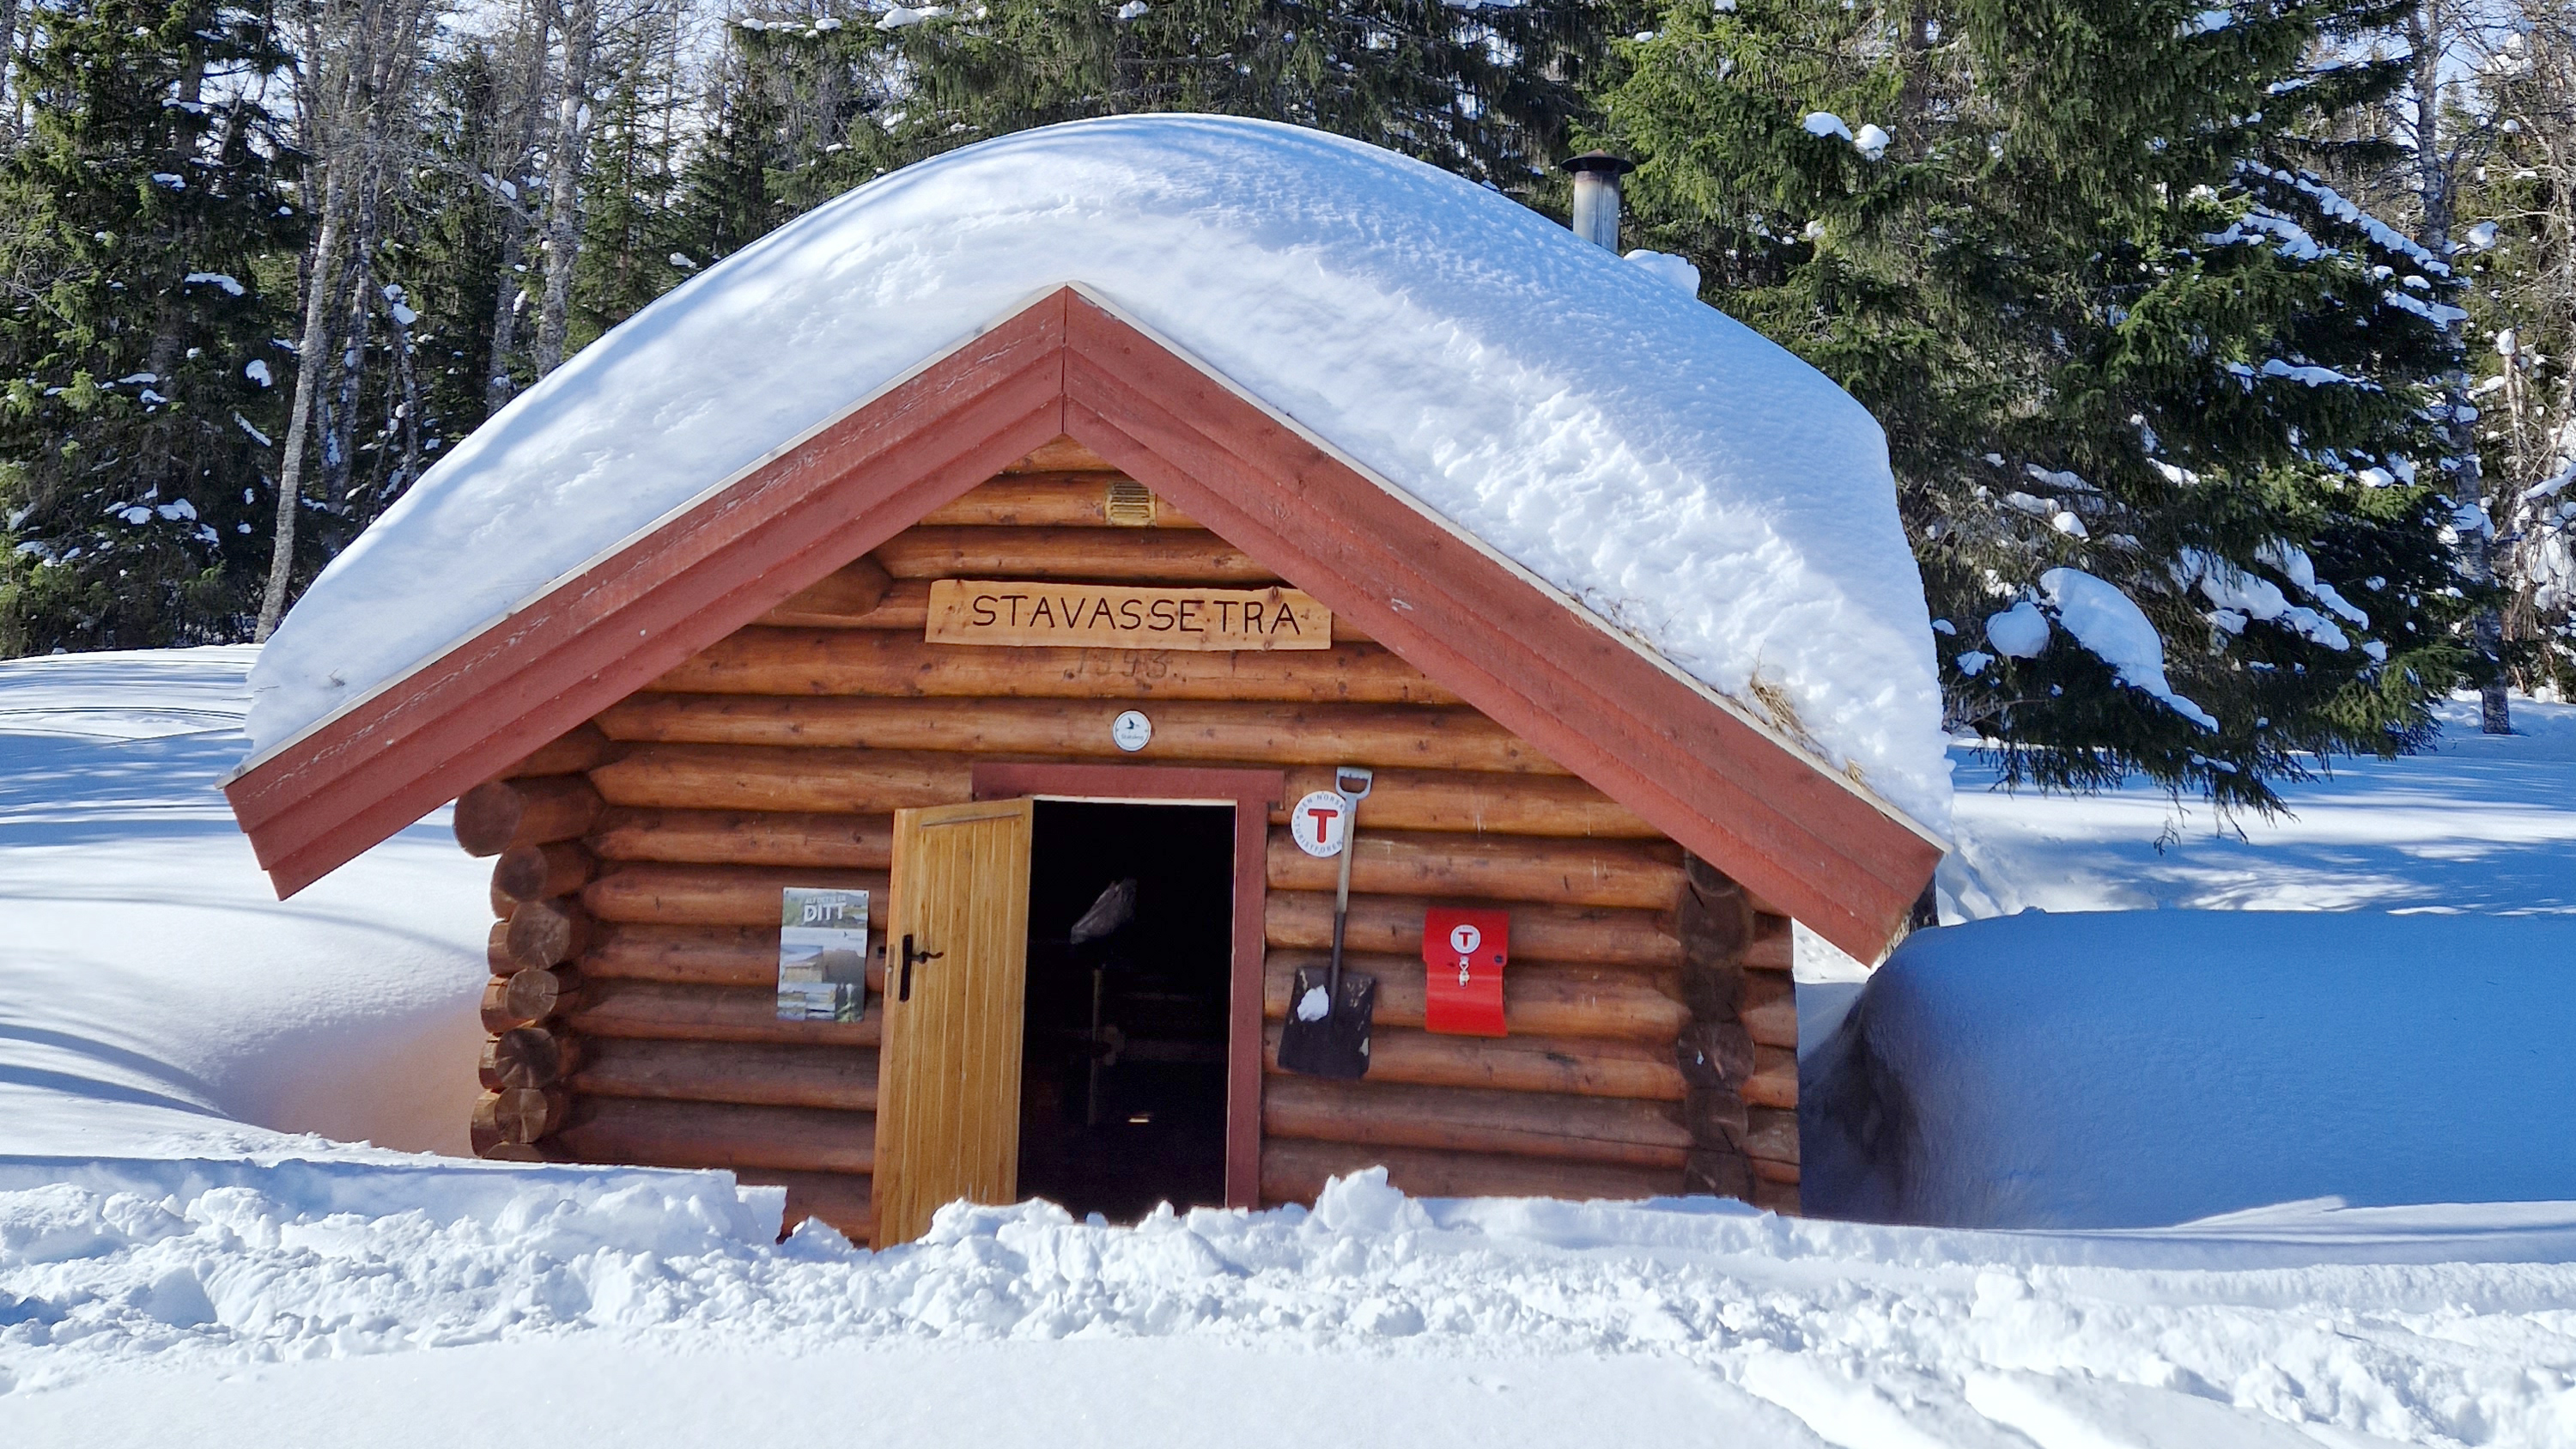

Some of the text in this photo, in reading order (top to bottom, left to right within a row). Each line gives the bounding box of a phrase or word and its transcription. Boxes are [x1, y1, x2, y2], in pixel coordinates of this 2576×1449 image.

[972, 594, 1301, 636] STAVASSETRA
[1308, 808, 1338, 843] T
[804, 903, 847, 922] DITT
[1458, 932, 1473, 947] T
